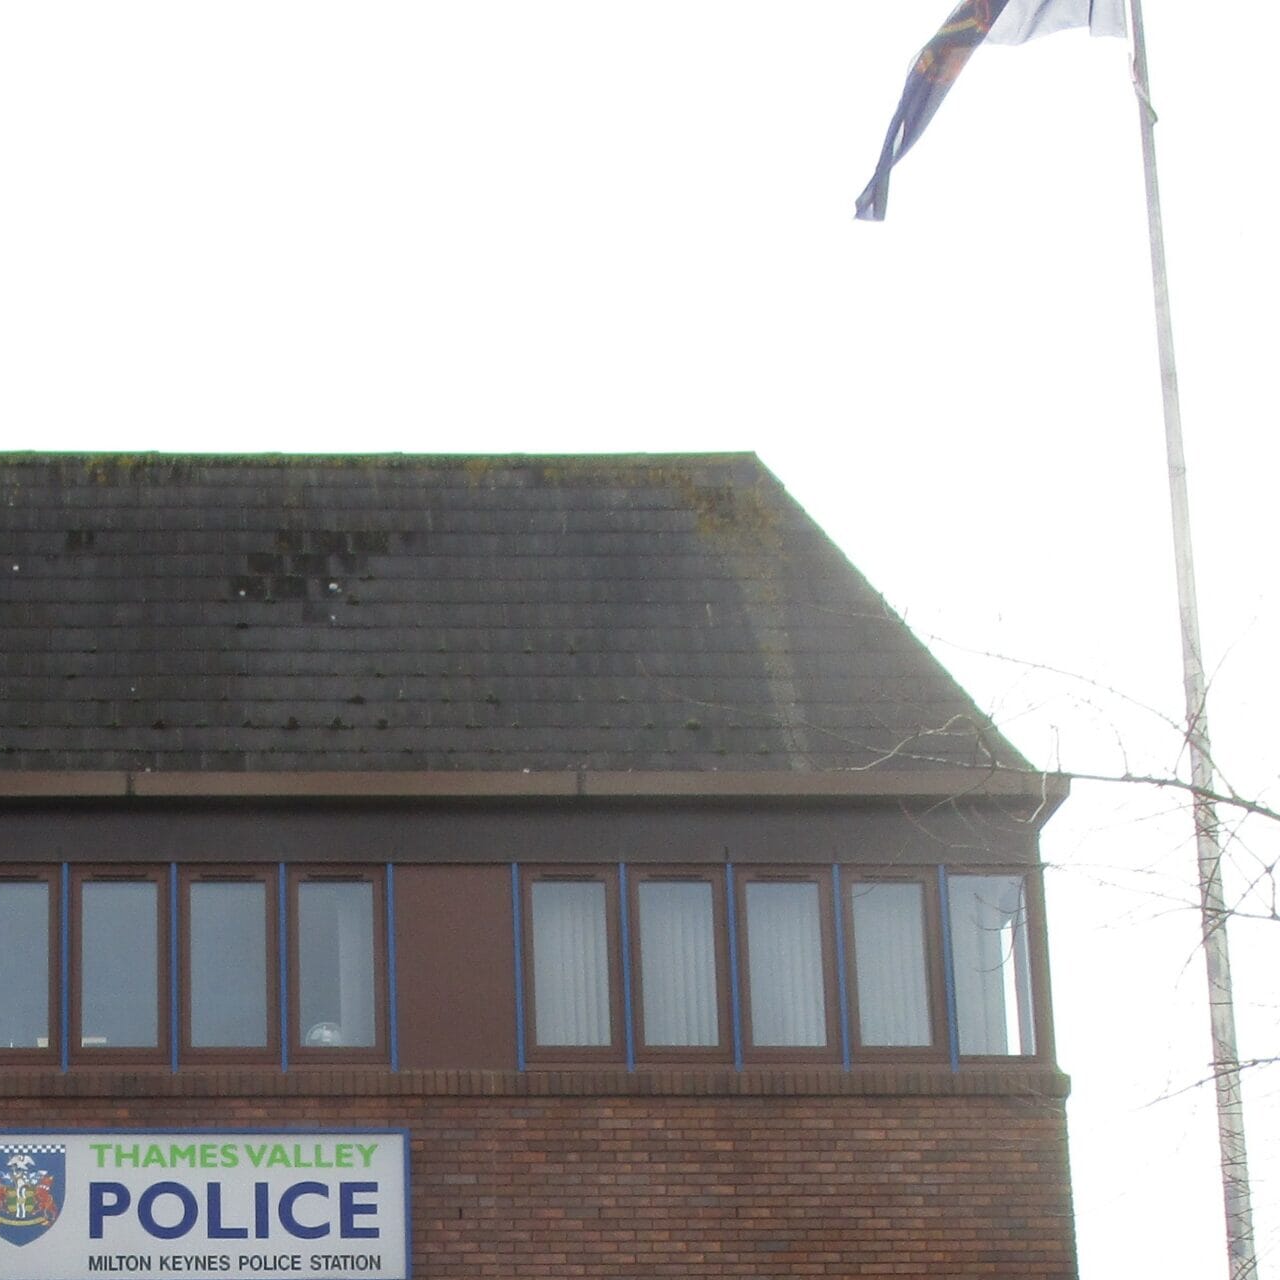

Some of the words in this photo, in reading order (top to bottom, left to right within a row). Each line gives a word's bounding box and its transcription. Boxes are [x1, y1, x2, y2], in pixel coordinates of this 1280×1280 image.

[89, 1143, 239, 1169] THAMES
[243, 1143, 379, 1169] VALLEY
[88, 1181, 380, 1240] POLICE
[88, 1255, 151, 1272] MILTON
[159, 1255, 231, 1272] KEYNES
[238, 1255, 302, 1272] POLICE
[309, 1255, 382, 1272] STATION
